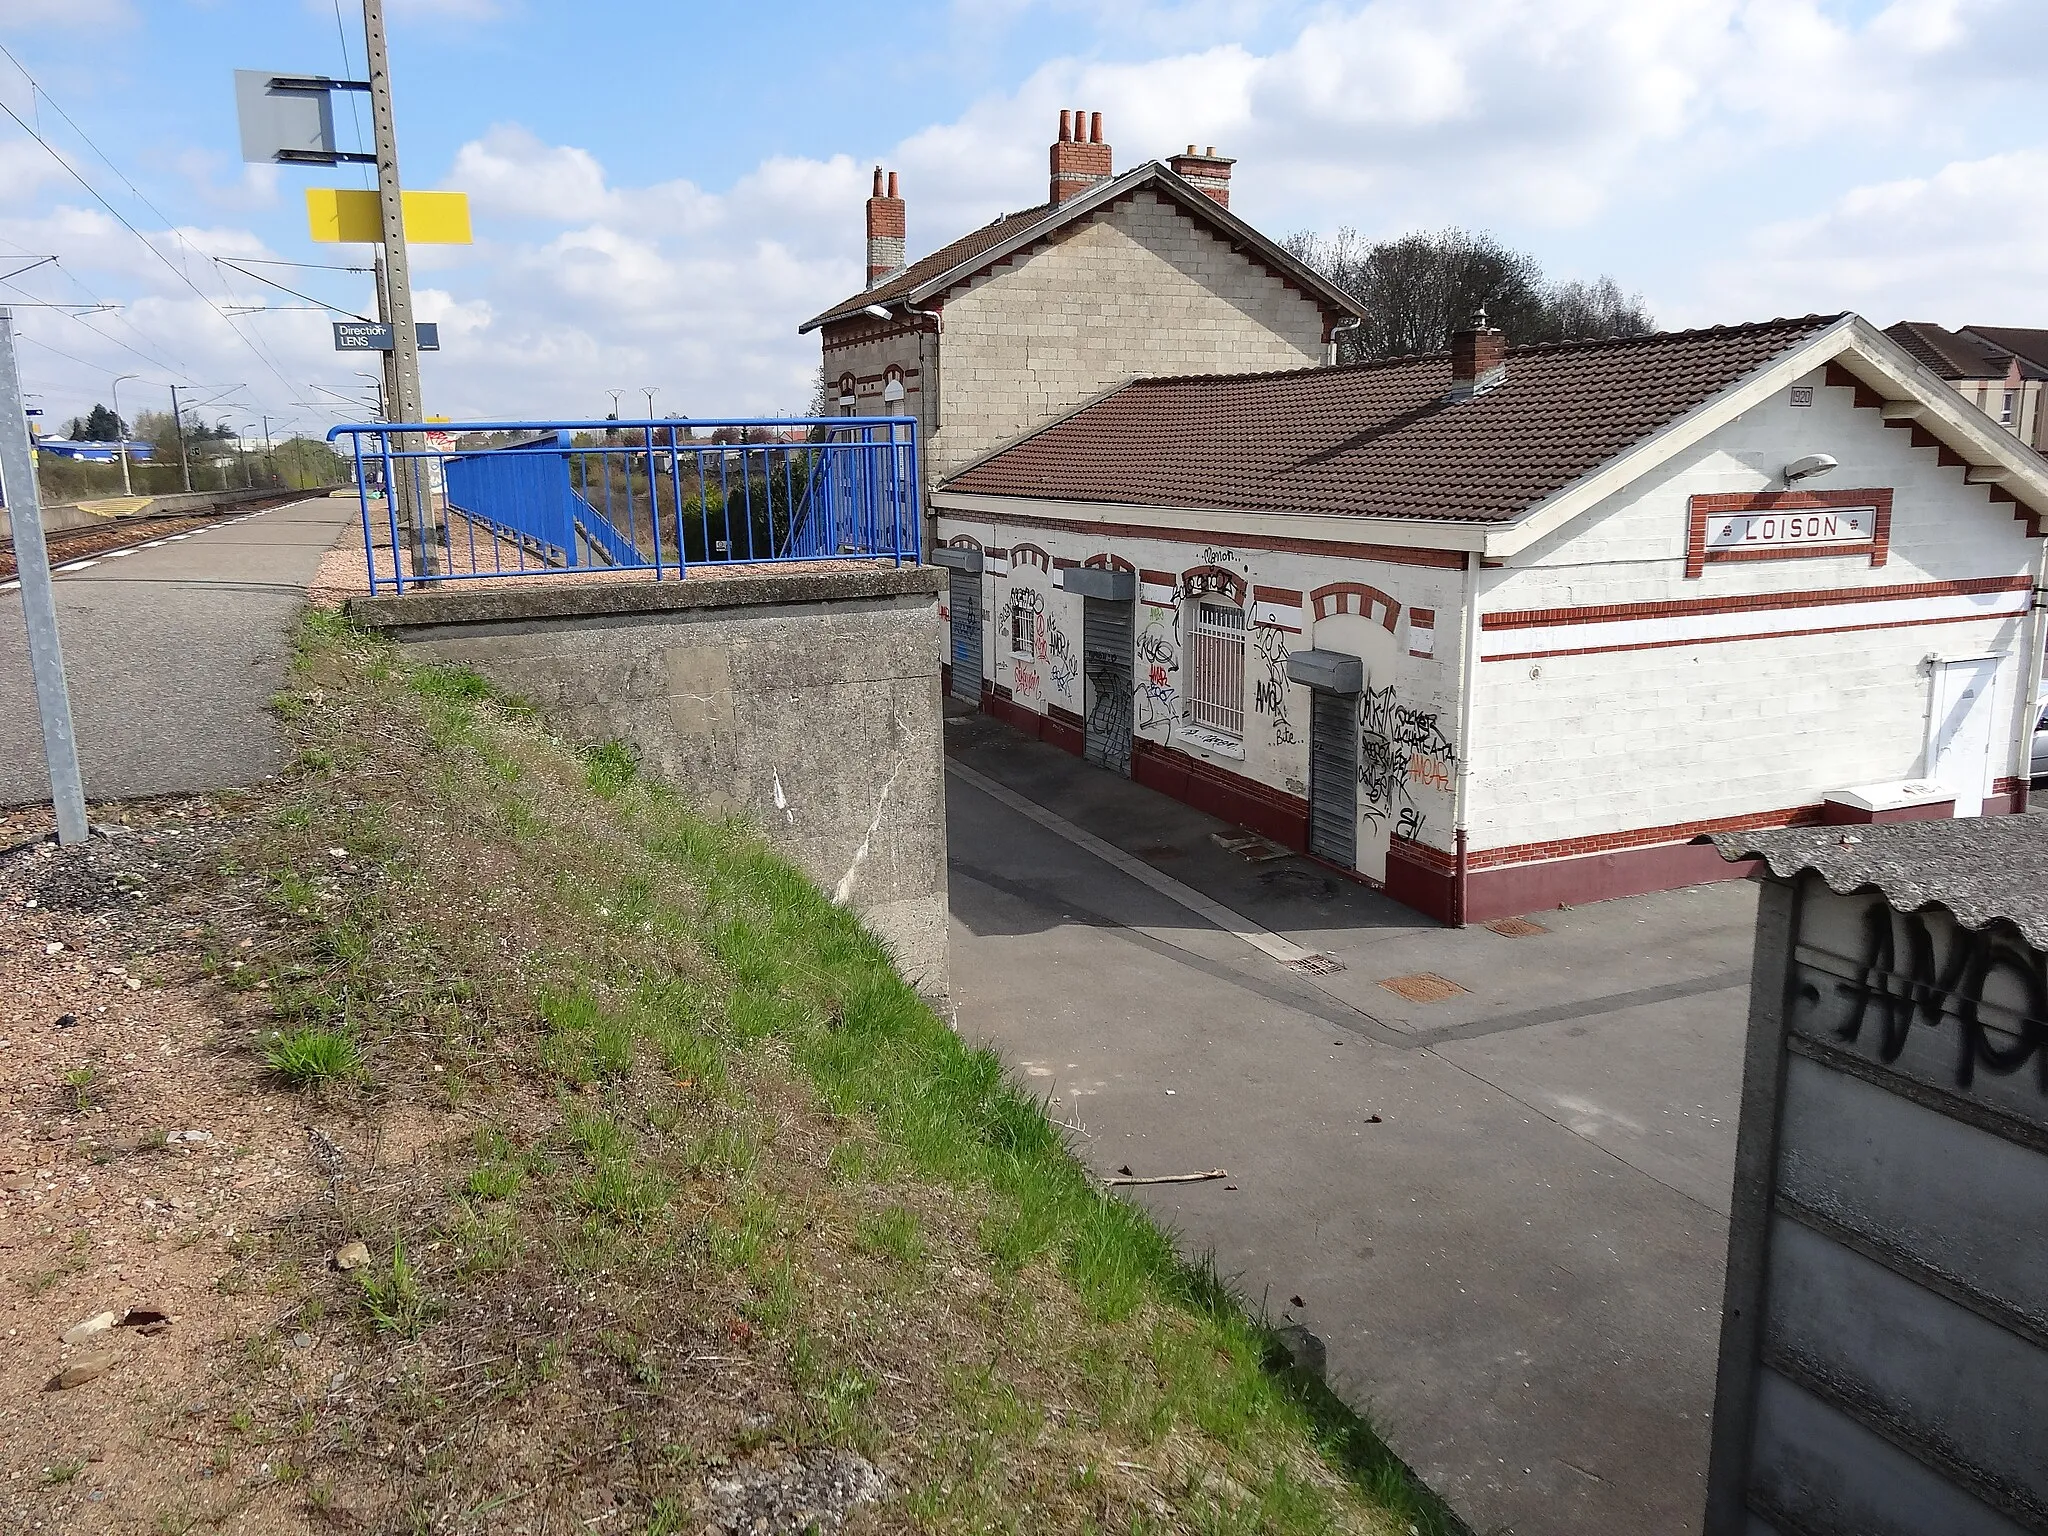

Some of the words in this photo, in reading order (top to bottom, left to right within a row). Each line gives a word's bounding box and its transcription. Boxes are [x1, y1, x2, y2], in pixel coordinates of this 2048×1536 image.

[340, 325, 387, 336] Direction
[341, 336, 369, 347] LENS
[1792, 390, 1811, 403] 1920
[1745, 515, 1838, 541] LOISON
